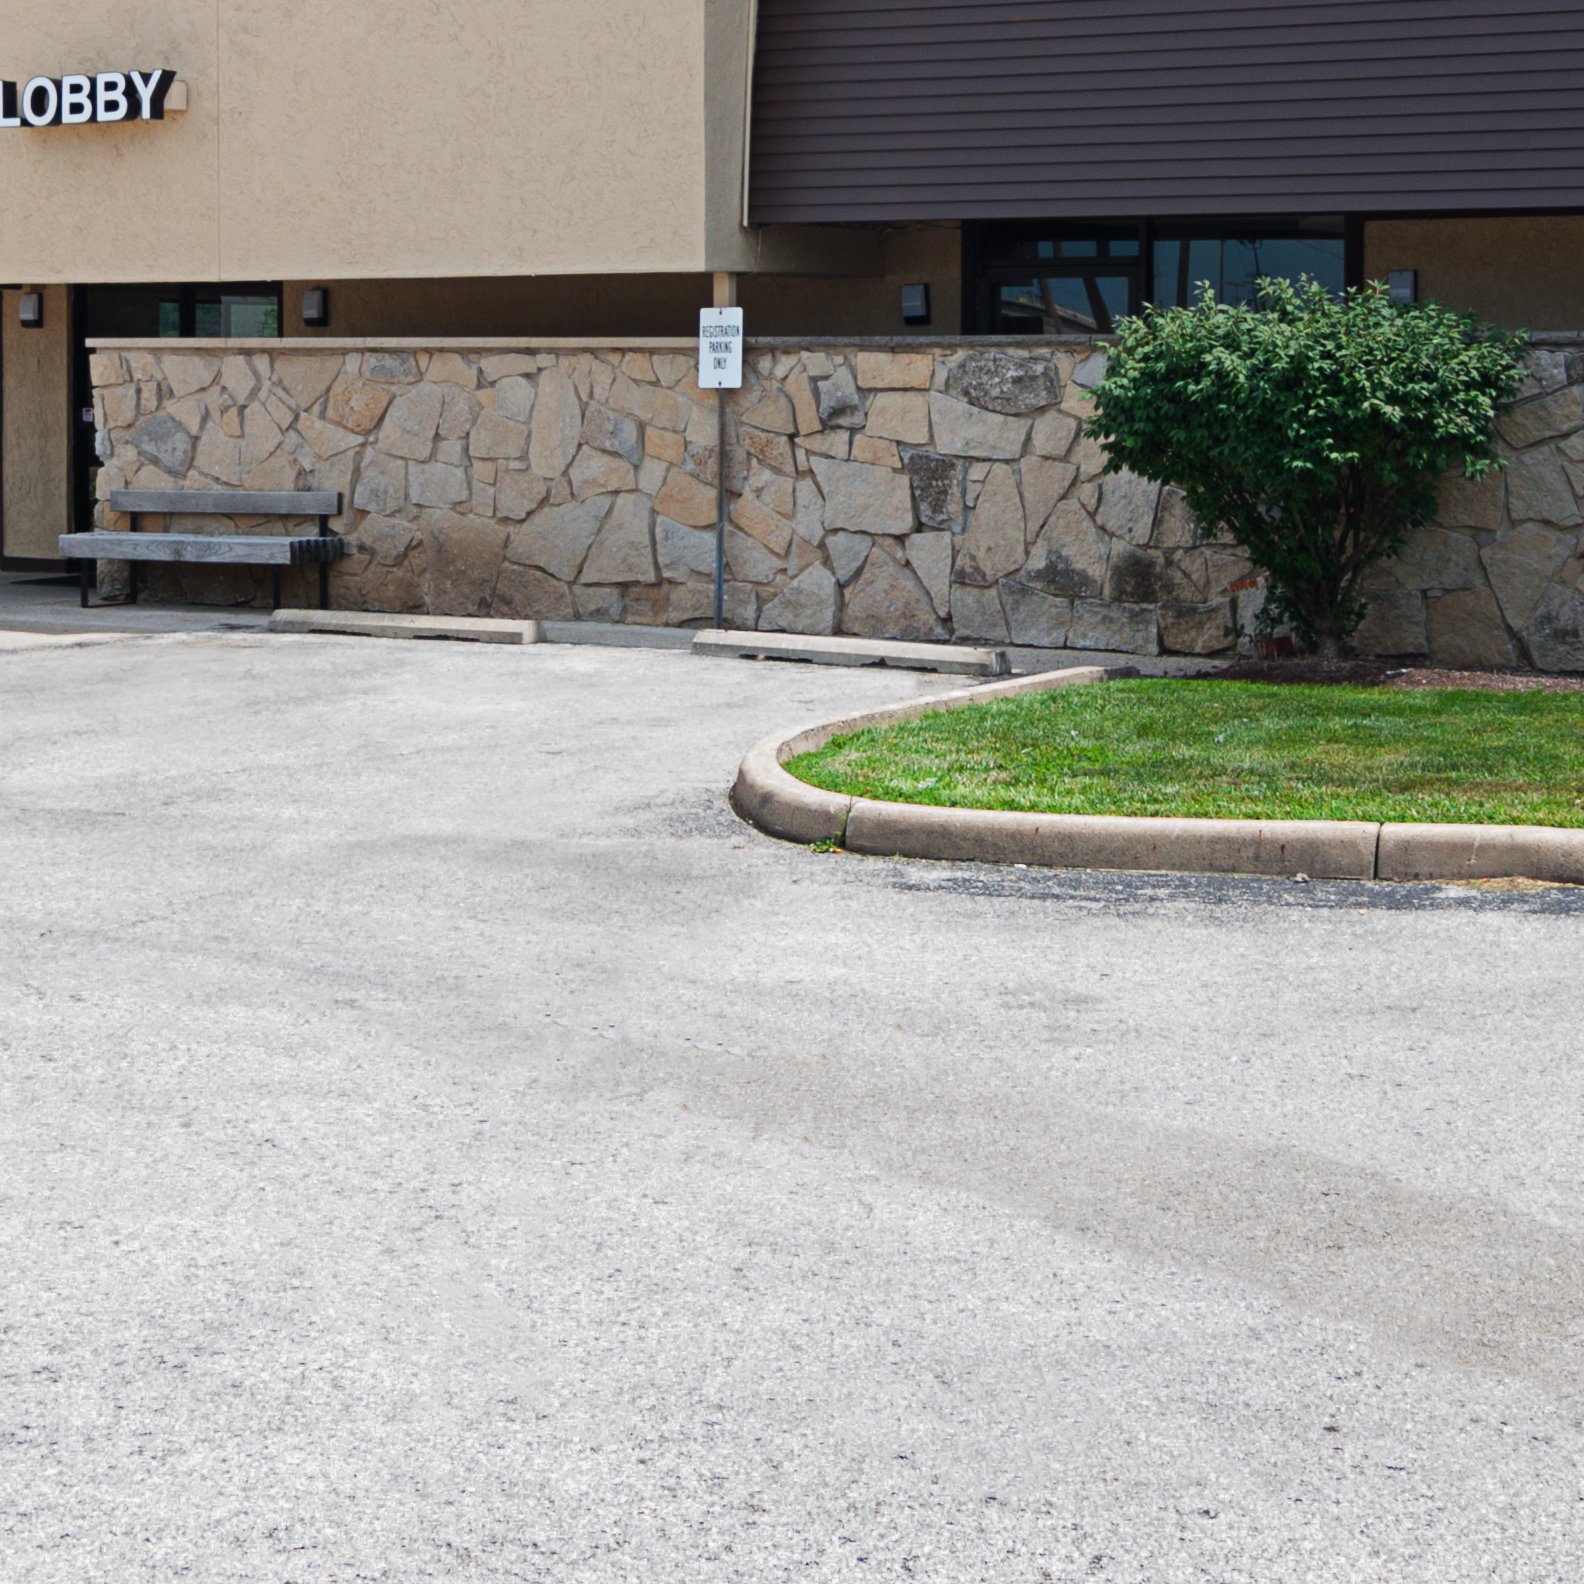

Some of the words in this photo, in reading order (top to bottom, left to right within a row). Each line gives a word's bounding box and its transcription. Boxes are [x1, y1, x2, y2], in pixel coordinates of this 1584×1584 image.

[702, 325, 740, 338] REGISTRATION
[709, 341, 732, 353] PARKING
[713, 357, 727, 369] ONLY
